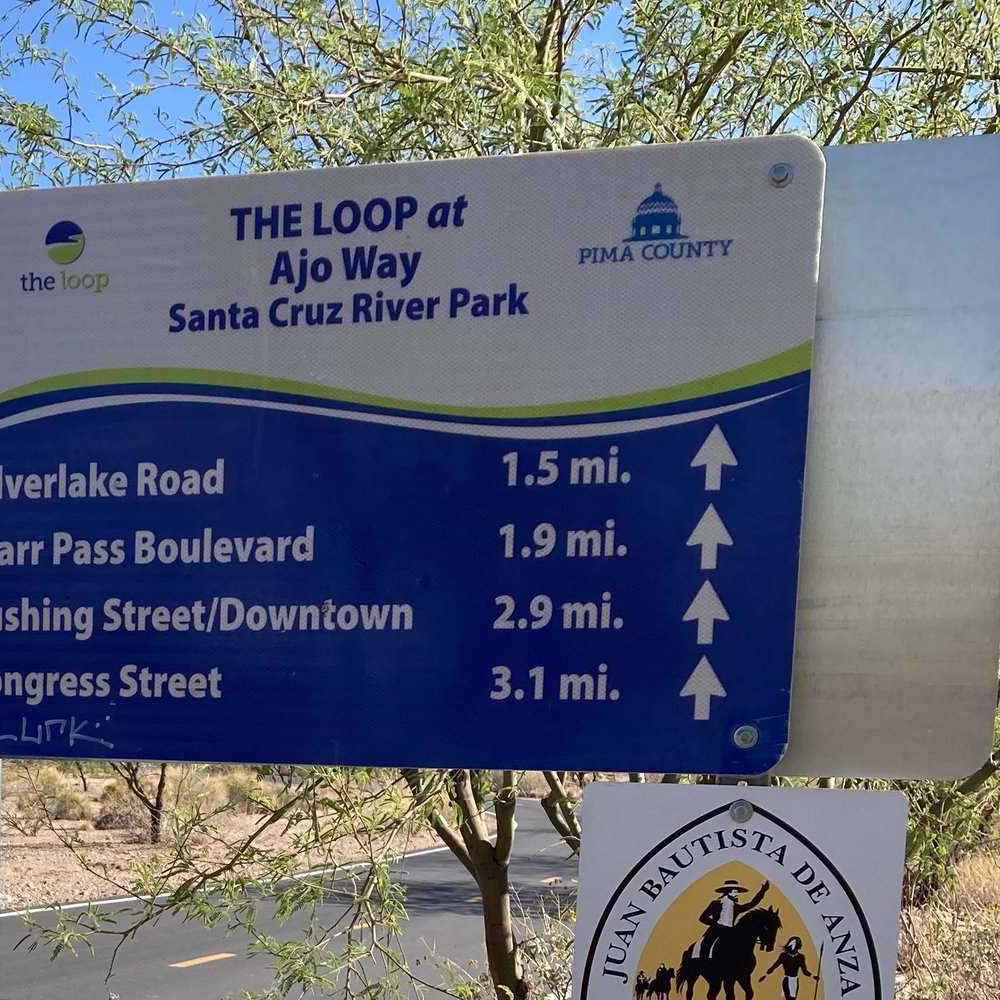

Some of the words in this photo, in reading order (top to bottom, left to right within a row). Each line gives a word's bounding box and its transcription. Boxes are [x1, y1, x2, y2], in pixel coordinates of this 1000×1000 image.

[230, 203, 302, 241] THE
[312, 196, 418, 236] LOOP
[427, 194, 469, 228] at
[270, 250, 333, 293] Ajo
[341, 246, 422, 288] Way
[578, 243, 635, 265] PIMA
[640, 239, 734, 262] COUNTY
[20, 271, 56, 292] the
[59, 270, 110, 293] loop
[168, 303, 260, 333] Santa
[268, 296, 344, 327] Cruz
[352, 292, 441, 324] River
[449, 283, 530, 319] Park
[136, 458, 225, 497] Road
[501, 450, 560, 487] 1.5
[569, 445, 632, 485] mi.
[52, 531, 126, 566] Pass
[134, 525, 316, 565] Boulevard
[498, 522, 557, 558] 1.9
[566, 519, 628, 558] mi.
[102, 596, 415, 633] Street/Downtown
[492, 593, 554, 631] 2.9
[561, 591, 625, 631] mi.
[119, 664, 223, 699] Street
[489, 665, 546, 701] 3.1
[558, 663, 621, 701] mi.
[602, 900, 647, 985] JUAN
[639, 827, 789, 902] BAUTISTA
[790, 861, 831, 905] DE
[821, 911, 862, 997] ANZA
